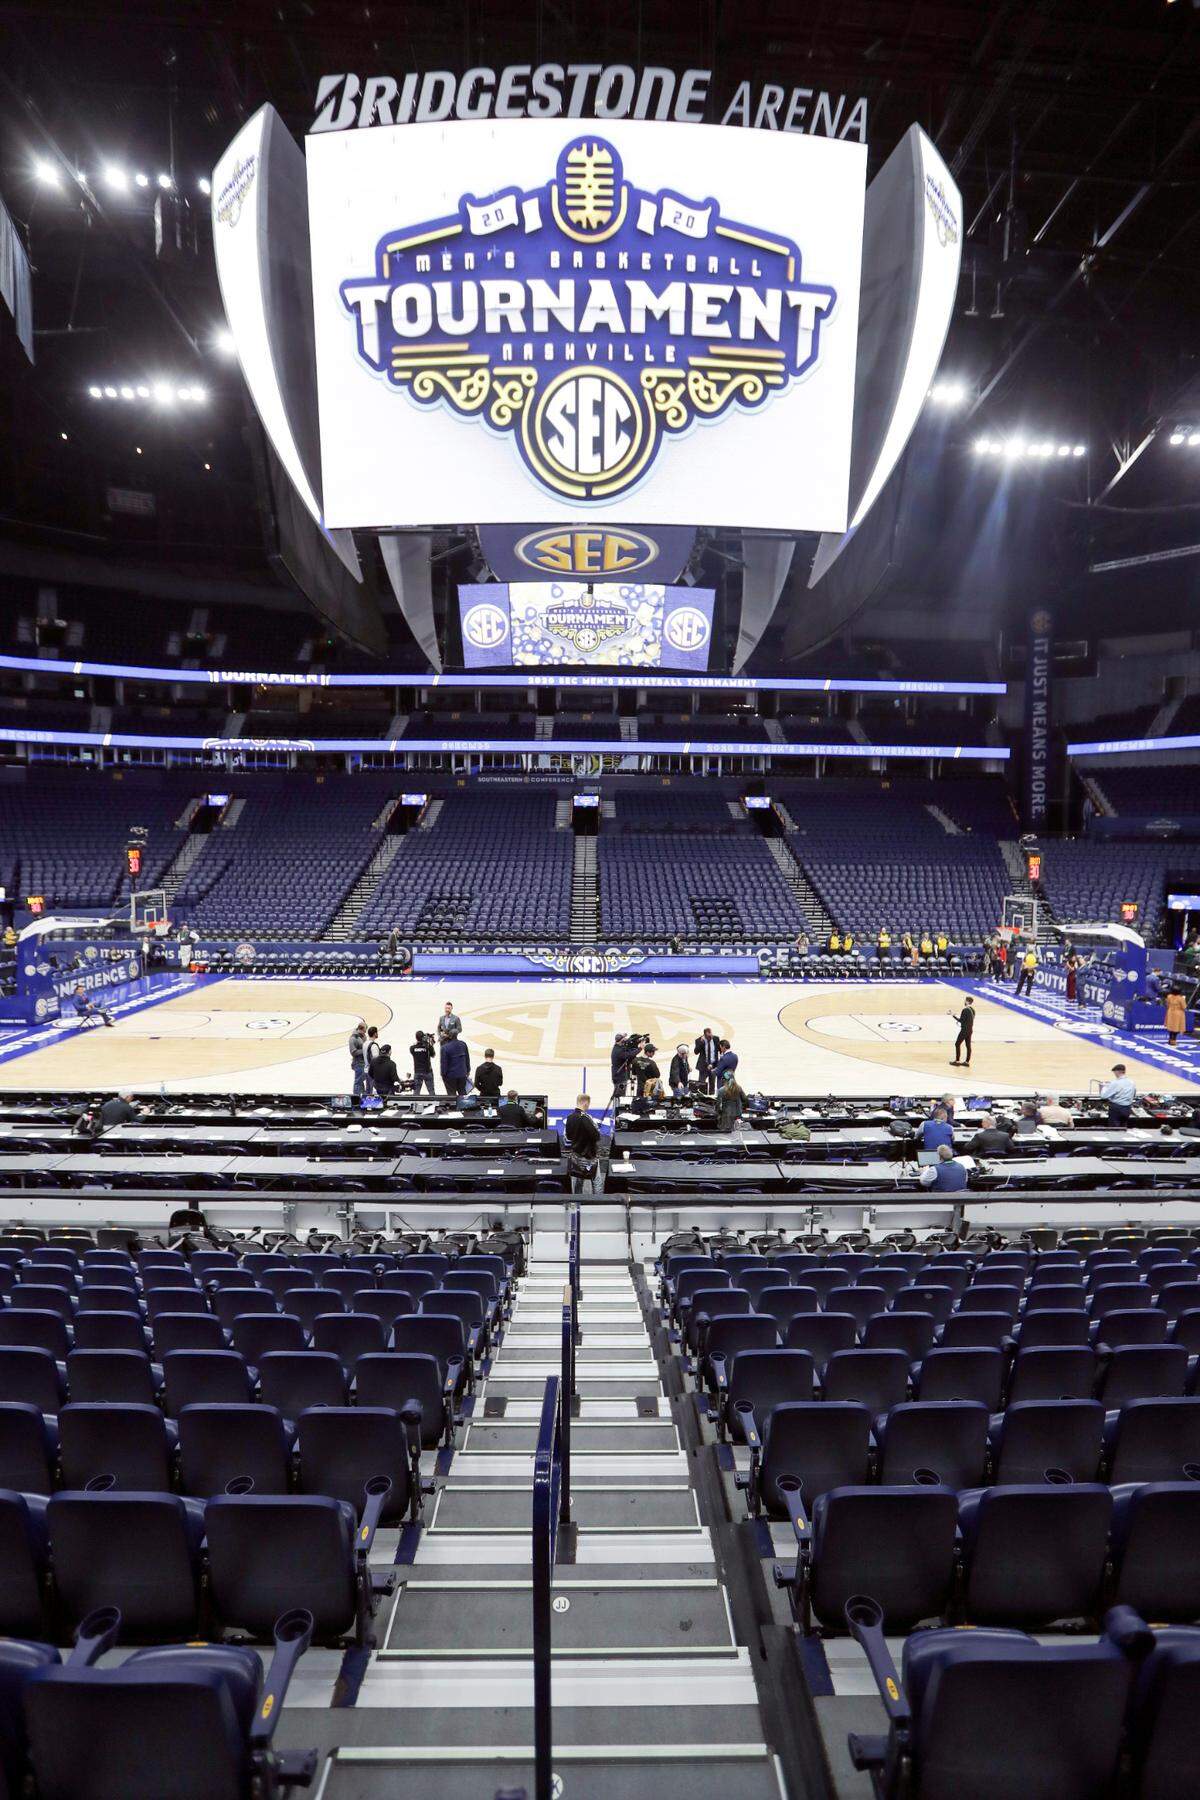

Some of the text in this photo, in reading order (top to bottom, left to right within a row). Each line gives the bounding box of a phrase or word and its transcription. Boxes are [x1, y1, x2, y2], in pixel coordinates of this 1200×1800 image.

[309, 63, 869, 145] BRIDGESTONE ARENA
[482, 208, 695, 229] 20 20
[415, 250, 762, 277] MEN'S BASKETBALL
[344, 278, 832, 368] TOURNAMENT
[502, 342, 676, 363] NASHVILLE
[545, 376, 632, 475] SEC
[533, 533, 640, 572] SEC
[465, 610, 504, 644] SEC
[540, 613, 636, 627] TOURNAMENT
[665, 613, 705, 648] SEC
[1033, 638, 1048, 652] IT
[528, 677, 555, 685] 2020
[559, 677, 578, 685] SEC
[618, 678, 682, 686] BASKETBALL
[687, 679, 757, 687] TOURNAMENT
[1032, 658, 1048, 696] JUST
[1031, 703, 1048, 760] MEANS
[555, 1600, 567, 1609] JJ
